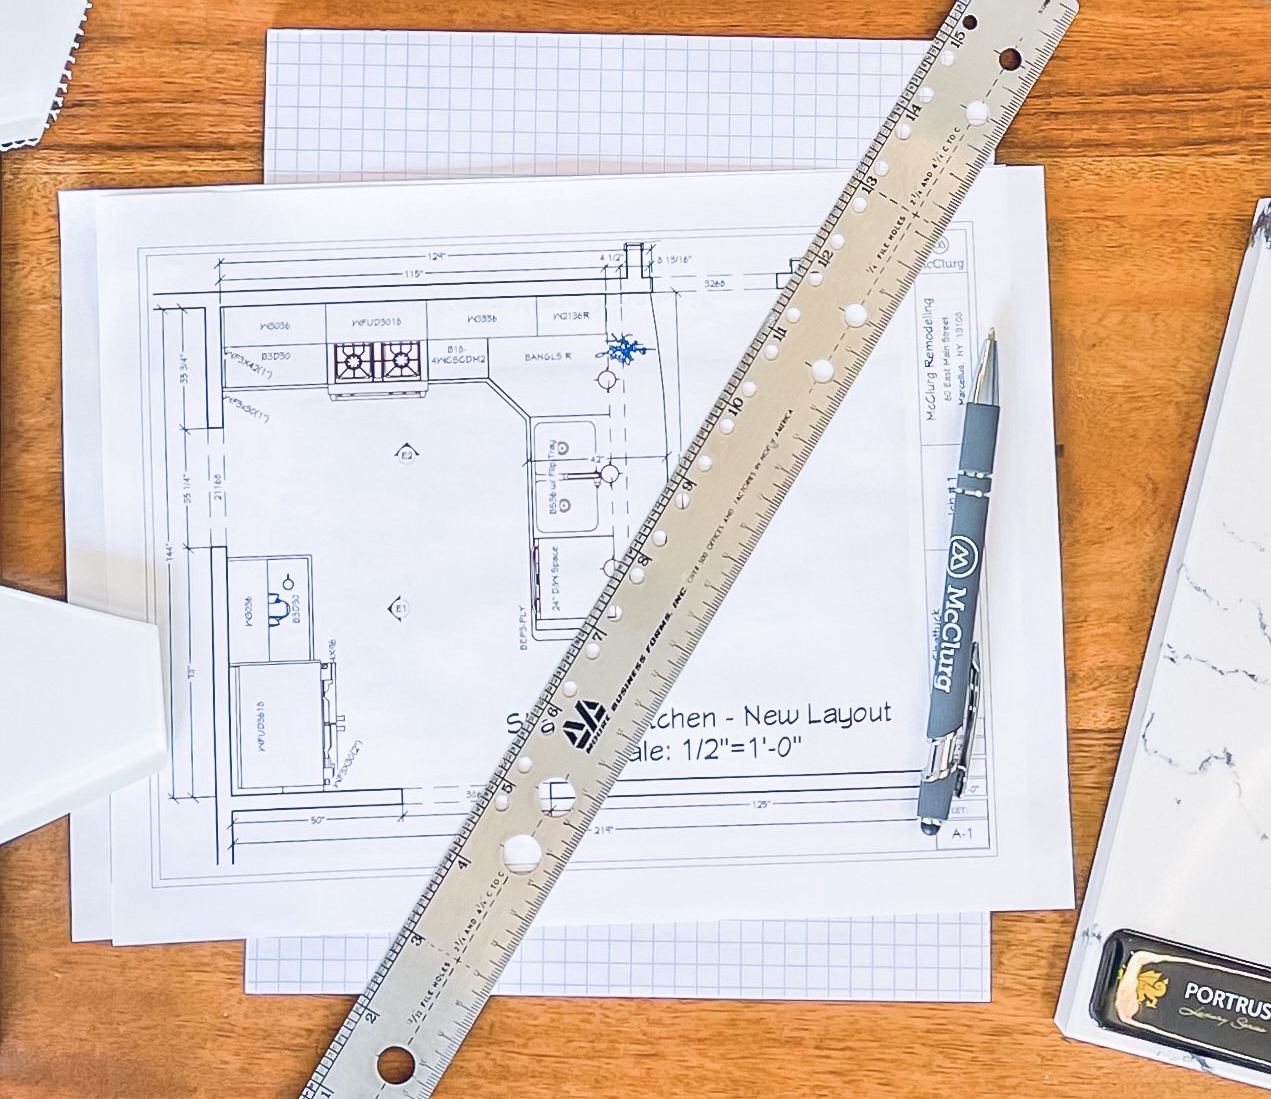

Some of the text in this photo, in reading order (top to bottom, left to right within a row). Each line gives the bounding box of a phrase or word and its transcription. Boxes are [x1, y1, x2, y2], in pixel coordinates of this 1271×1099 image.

[950, 31, 966, 49] 15
[906, 103, 922, 121] 14
[862, 175, 878, 195] 13
[876, 243, 890, 259] FILE
[888, 215, 906, 241] HOLES
[920, 171, 932, 187] AND
[942, 145, 950, 153] C
[946, 133, 956, 145] TO
[818, 249, 834, 269] 12
[923, 258, 964, 269] cClurg
[405, 269, 424, 278] 115"
[772, 327, 788, 341] 11
[940, 316, 949, 342] Street
[920, 297, 938, 420] McClurg Remodeling
[942, 346, 950, 365] Main
[956, 343, 963, 356] NY
[943, 369, 951, 387] East
[728, 397, 744, 417] 10
[549, 439, 558, 458] Tray
[549, 461, 558, 476] Flip
[682, 481, 694, 491] 9
[165, 542, 173, 562] 144"
[551, 547, 560, 573] Space
[610, 655, 646, 711] BUSINESS
[672, 587, 686, 609] INC
[760, 437, 776, 461] NORH
[774, 409, 794, 437] AMERICA
[638, 555, 650, 567] 8
[592, 631, 602, 641] 7
[933, 587, 967, 693] McClurg
[546, 707, 558, 717] 6
[647, 706, 716, 729] chen
[744, 705, 799, 727] New
[808, 702, 892, 730] Layout
[628, 735, 803, 762] ale: 1/2"=1'-0"
[500, 783, 514, 795] 5
[310, 816, 325, 825] 50"
[951, 827, 973, 839] A-1
[458, 859, 468, 869] 4
[410, 935, 422, 947] 3
[420, 989, 434, 1007] FILE
[432, 961, 450, 987] HOLES
[464, 919, 476, 935] AND
[490, 879, 500, 889] TO
[364, 1013, 376, 1025] 2
